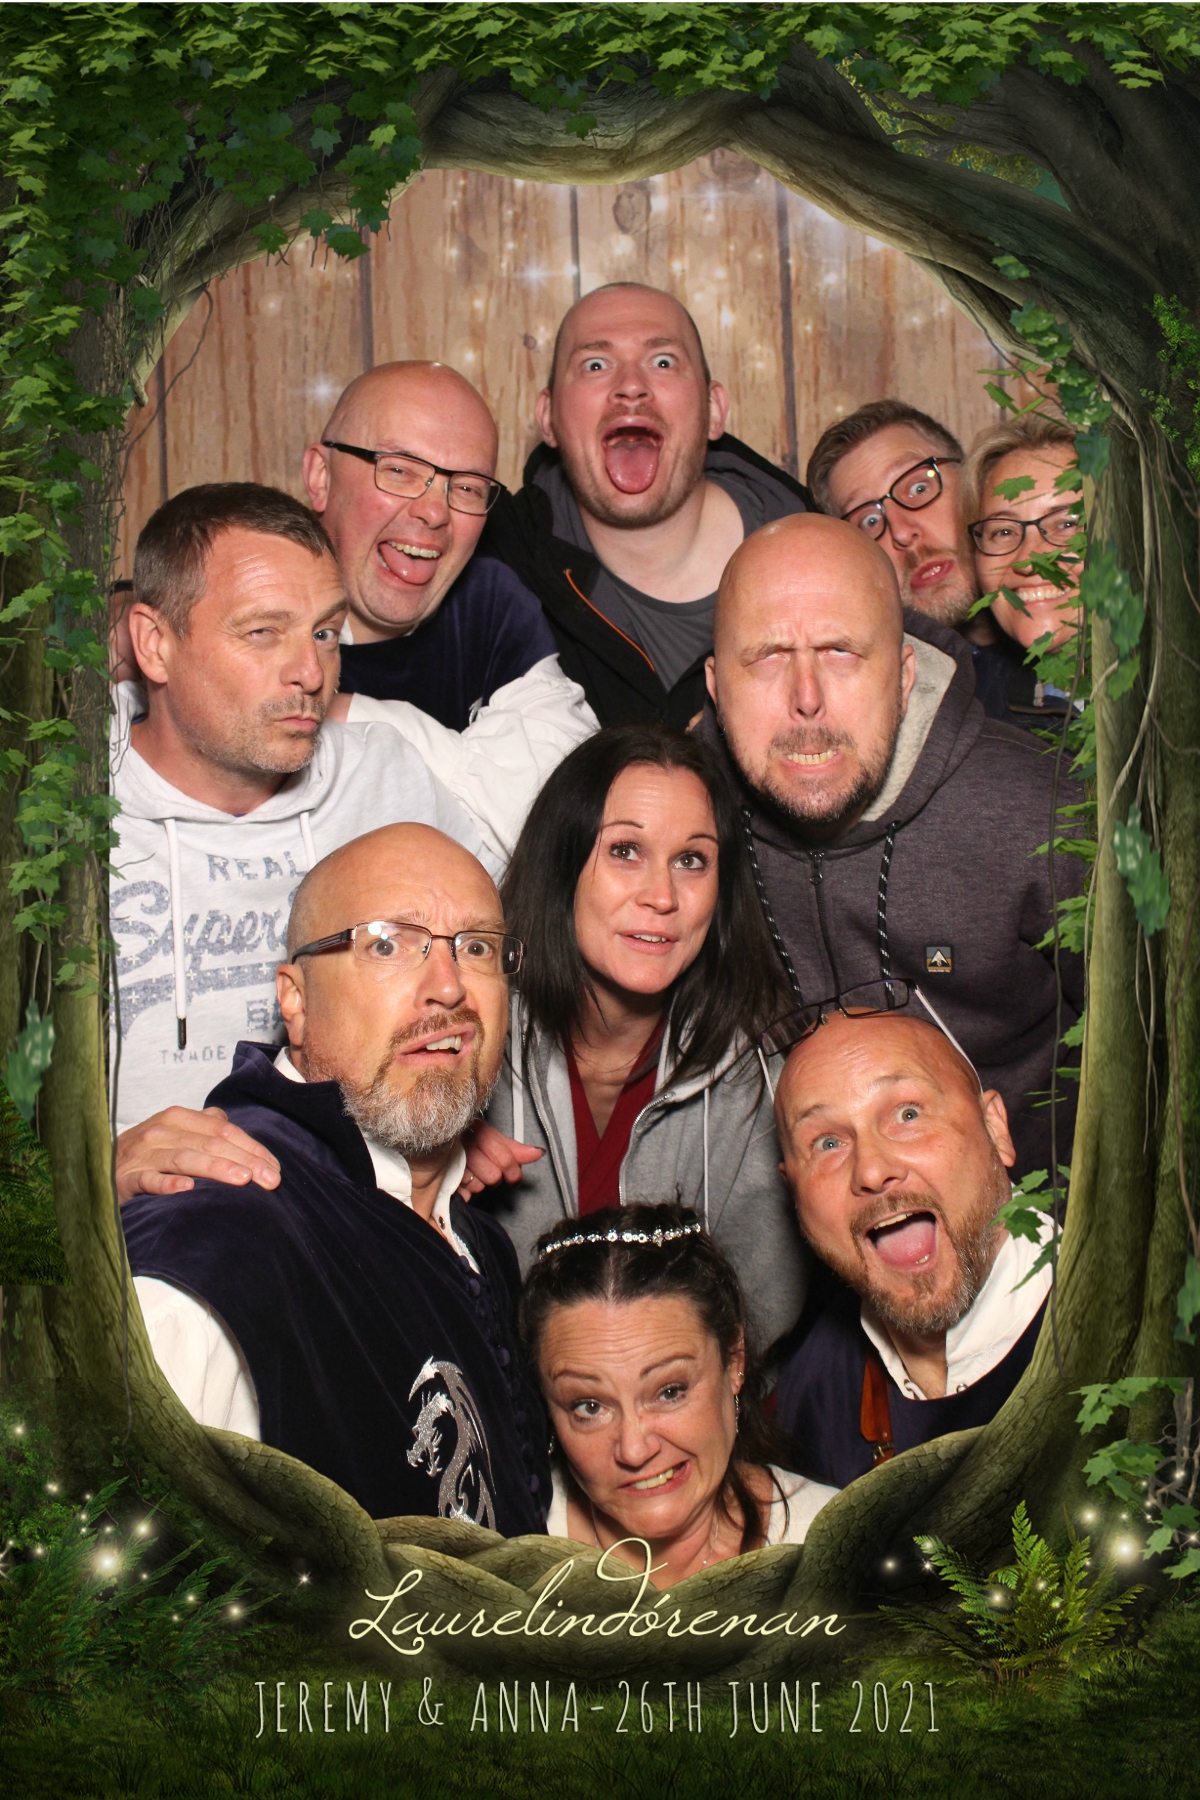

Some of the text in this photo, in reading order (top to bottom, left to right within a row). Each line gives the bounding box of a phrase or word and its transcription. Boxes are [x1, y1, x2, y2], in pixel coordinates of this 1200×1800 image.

[206, 851, 307, 882] REAL
[109, 880, 300, 977] Super
[160, 1045, 228, 1065] TRADE
